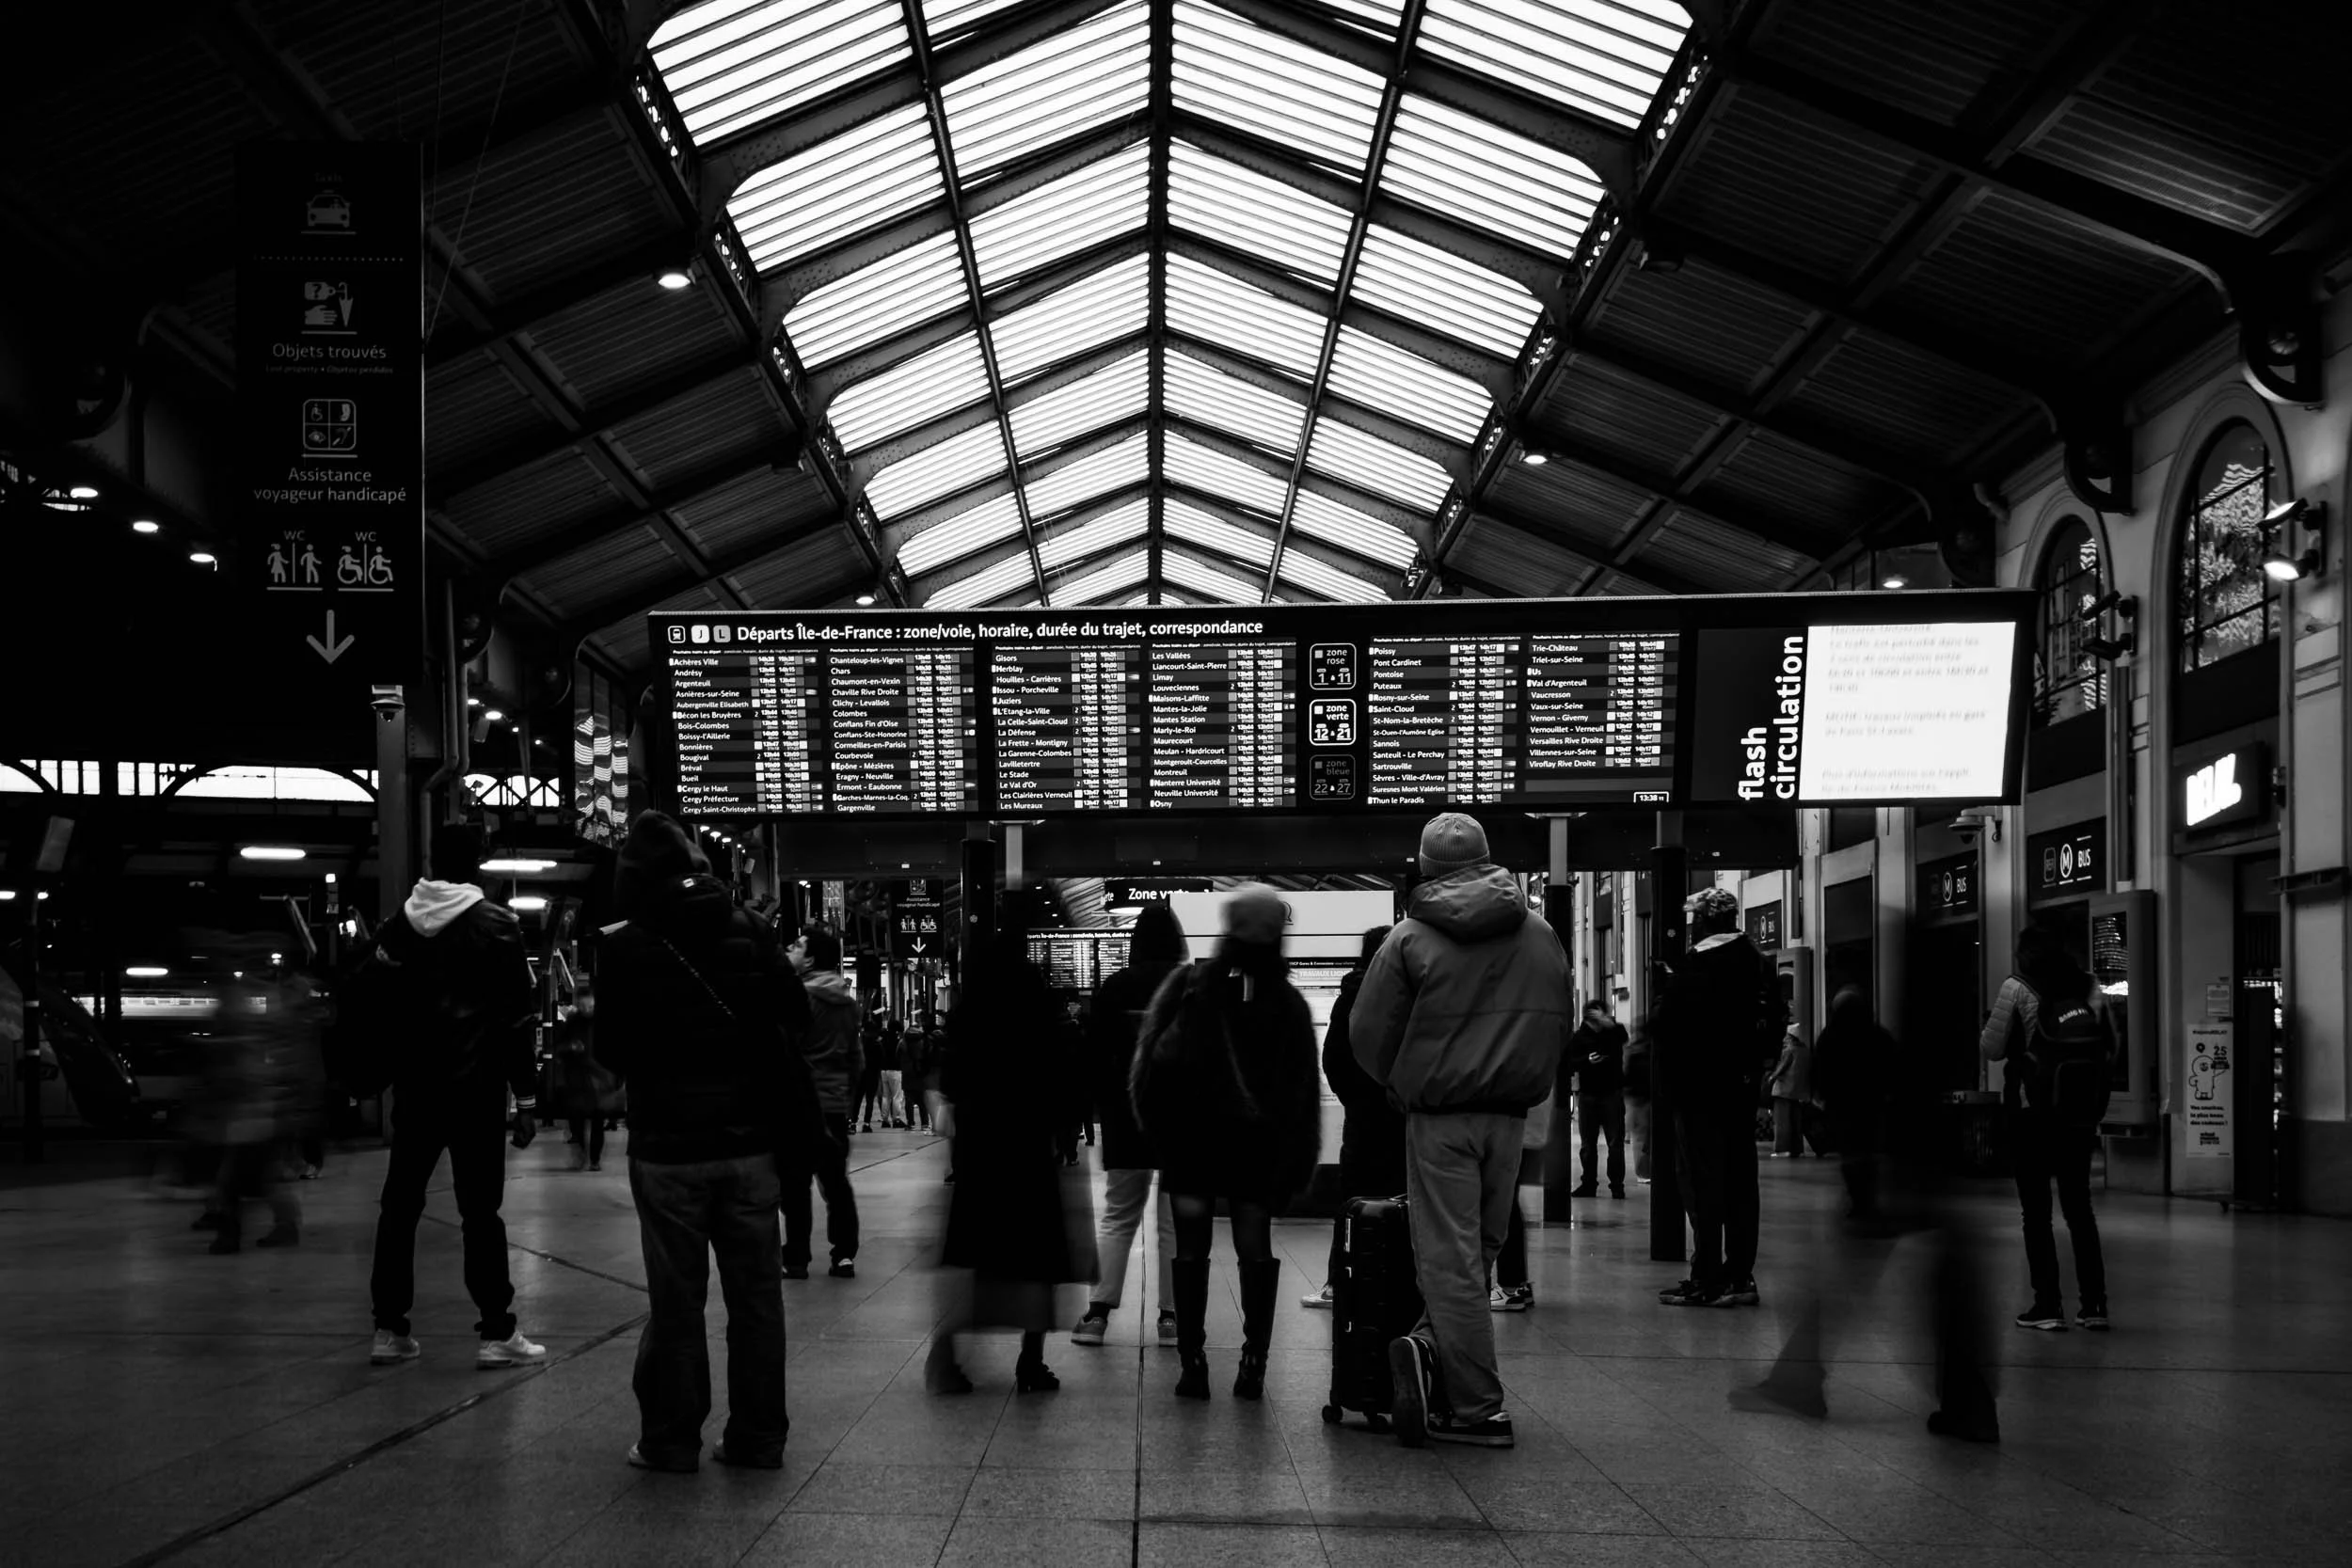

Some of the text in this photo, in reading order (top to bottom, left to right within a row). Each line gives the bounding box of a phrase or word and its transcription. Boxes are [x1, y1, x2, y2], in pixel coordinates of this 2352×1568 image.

[272, 342, 387, 361] Objets trouvés
[288, 467, 373, 483] Assistance
[253, 486, 407, 505] voyageur handicapé
[284, 530, 305, 541] WC
[355, 531, 376, 542] WC
[738, 620, 1263, 642] Départs Île-de-France zone/voie, horaire, durée du trajet, correspondance
[1337, 673, 1351, 683] 11
[1326, 712, 1349, 721] verte
[1770, 636, 1804, 800] circulation
[1314, 728, 1351, 739] 12 21
[1738, 727, 1767, 800] flash
[1326, 767, 1350, 775] bleue
[1314, 783, 1351, 793] 22 27
[2077, 848, 2091, 867] BUS
[1956, 877, 1966, 893] BUS
[1128, 887, 1157, 900] Zone
[2214, 1045, 2228, 1055] 25
